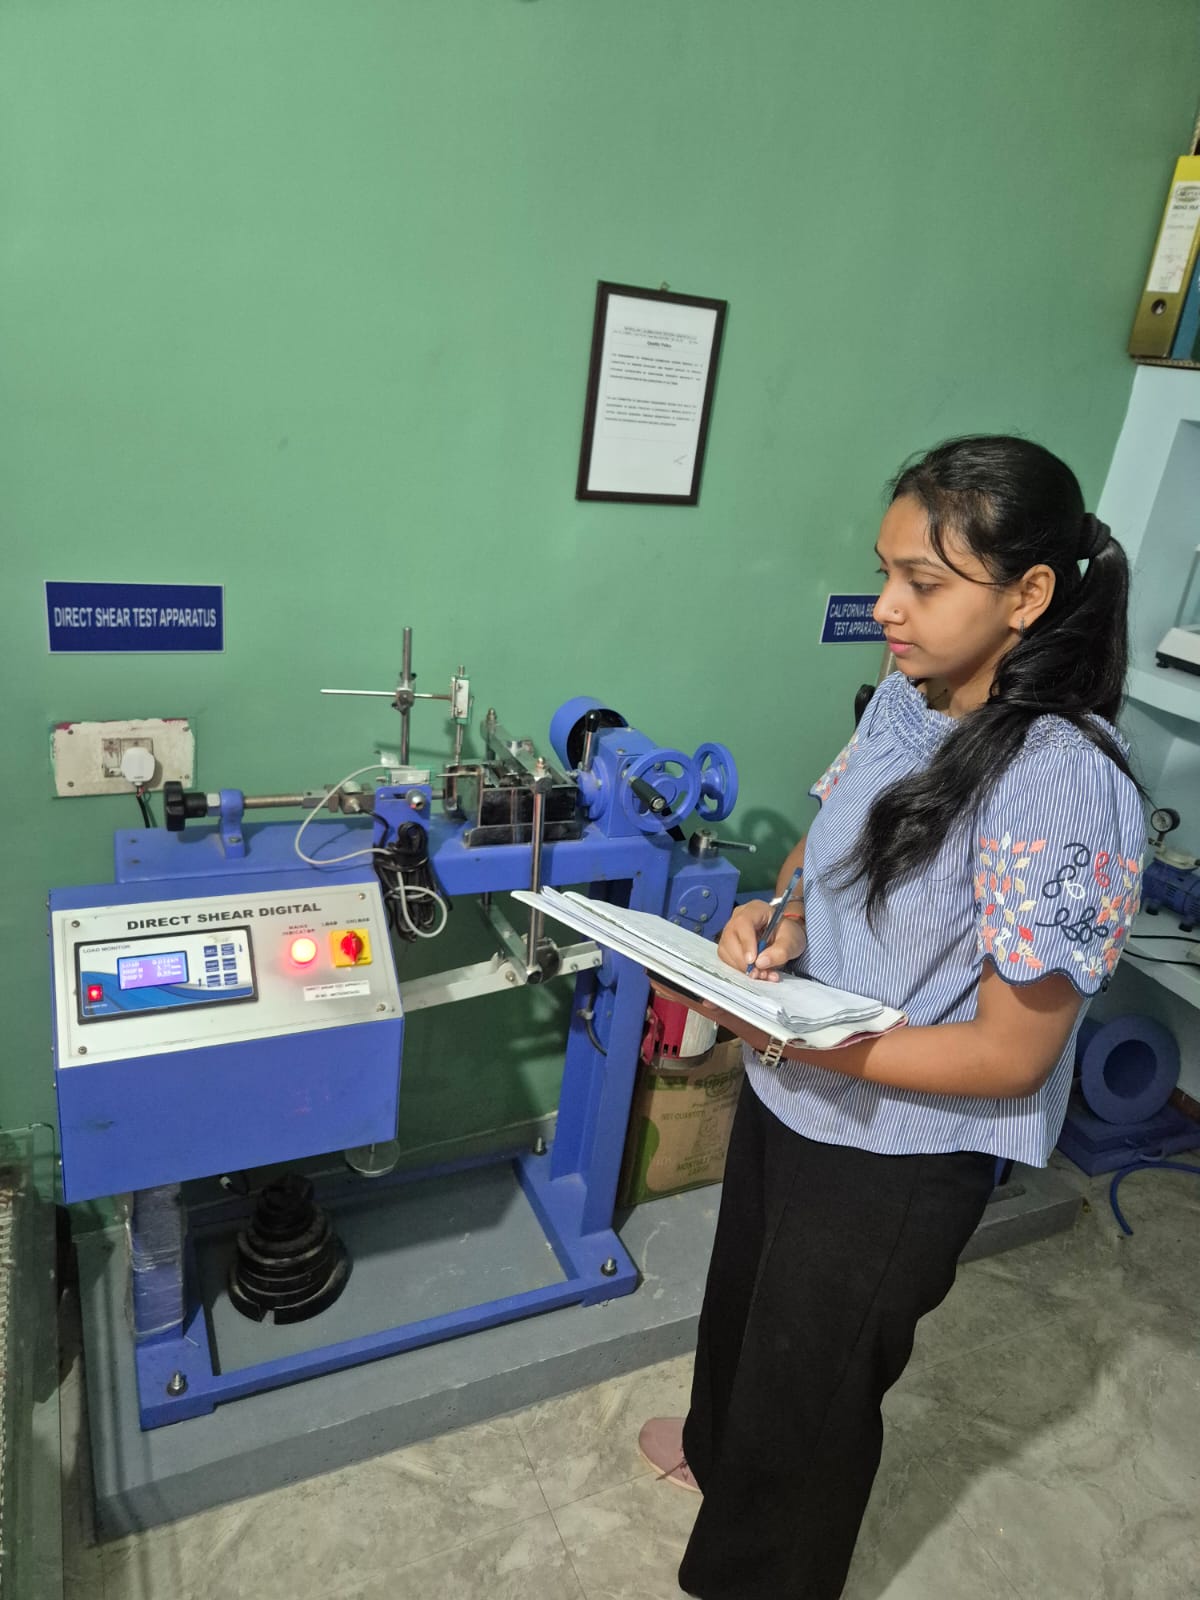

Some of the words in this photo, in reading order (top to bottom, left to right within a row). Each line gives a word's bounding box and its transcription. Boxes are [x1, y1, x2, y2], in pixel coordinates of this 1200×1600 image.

[54, 607, 93, 627] DIRECT
[95, 607, 131, 627] SHEAR
[133, 608, 158, 627] TEST
[159, 609, 217, 627] APPARATUS
[829, 603, 865, 618] CALIFORNIA
[834, 621, 850, 636] TEST
[848, 621, 882, 636] APPARATUS
[127, 915, 192, 930] DIRECT
[197, 909, 254, 923] SHEAR
[259, 903, 322, 917] DIGITAL
